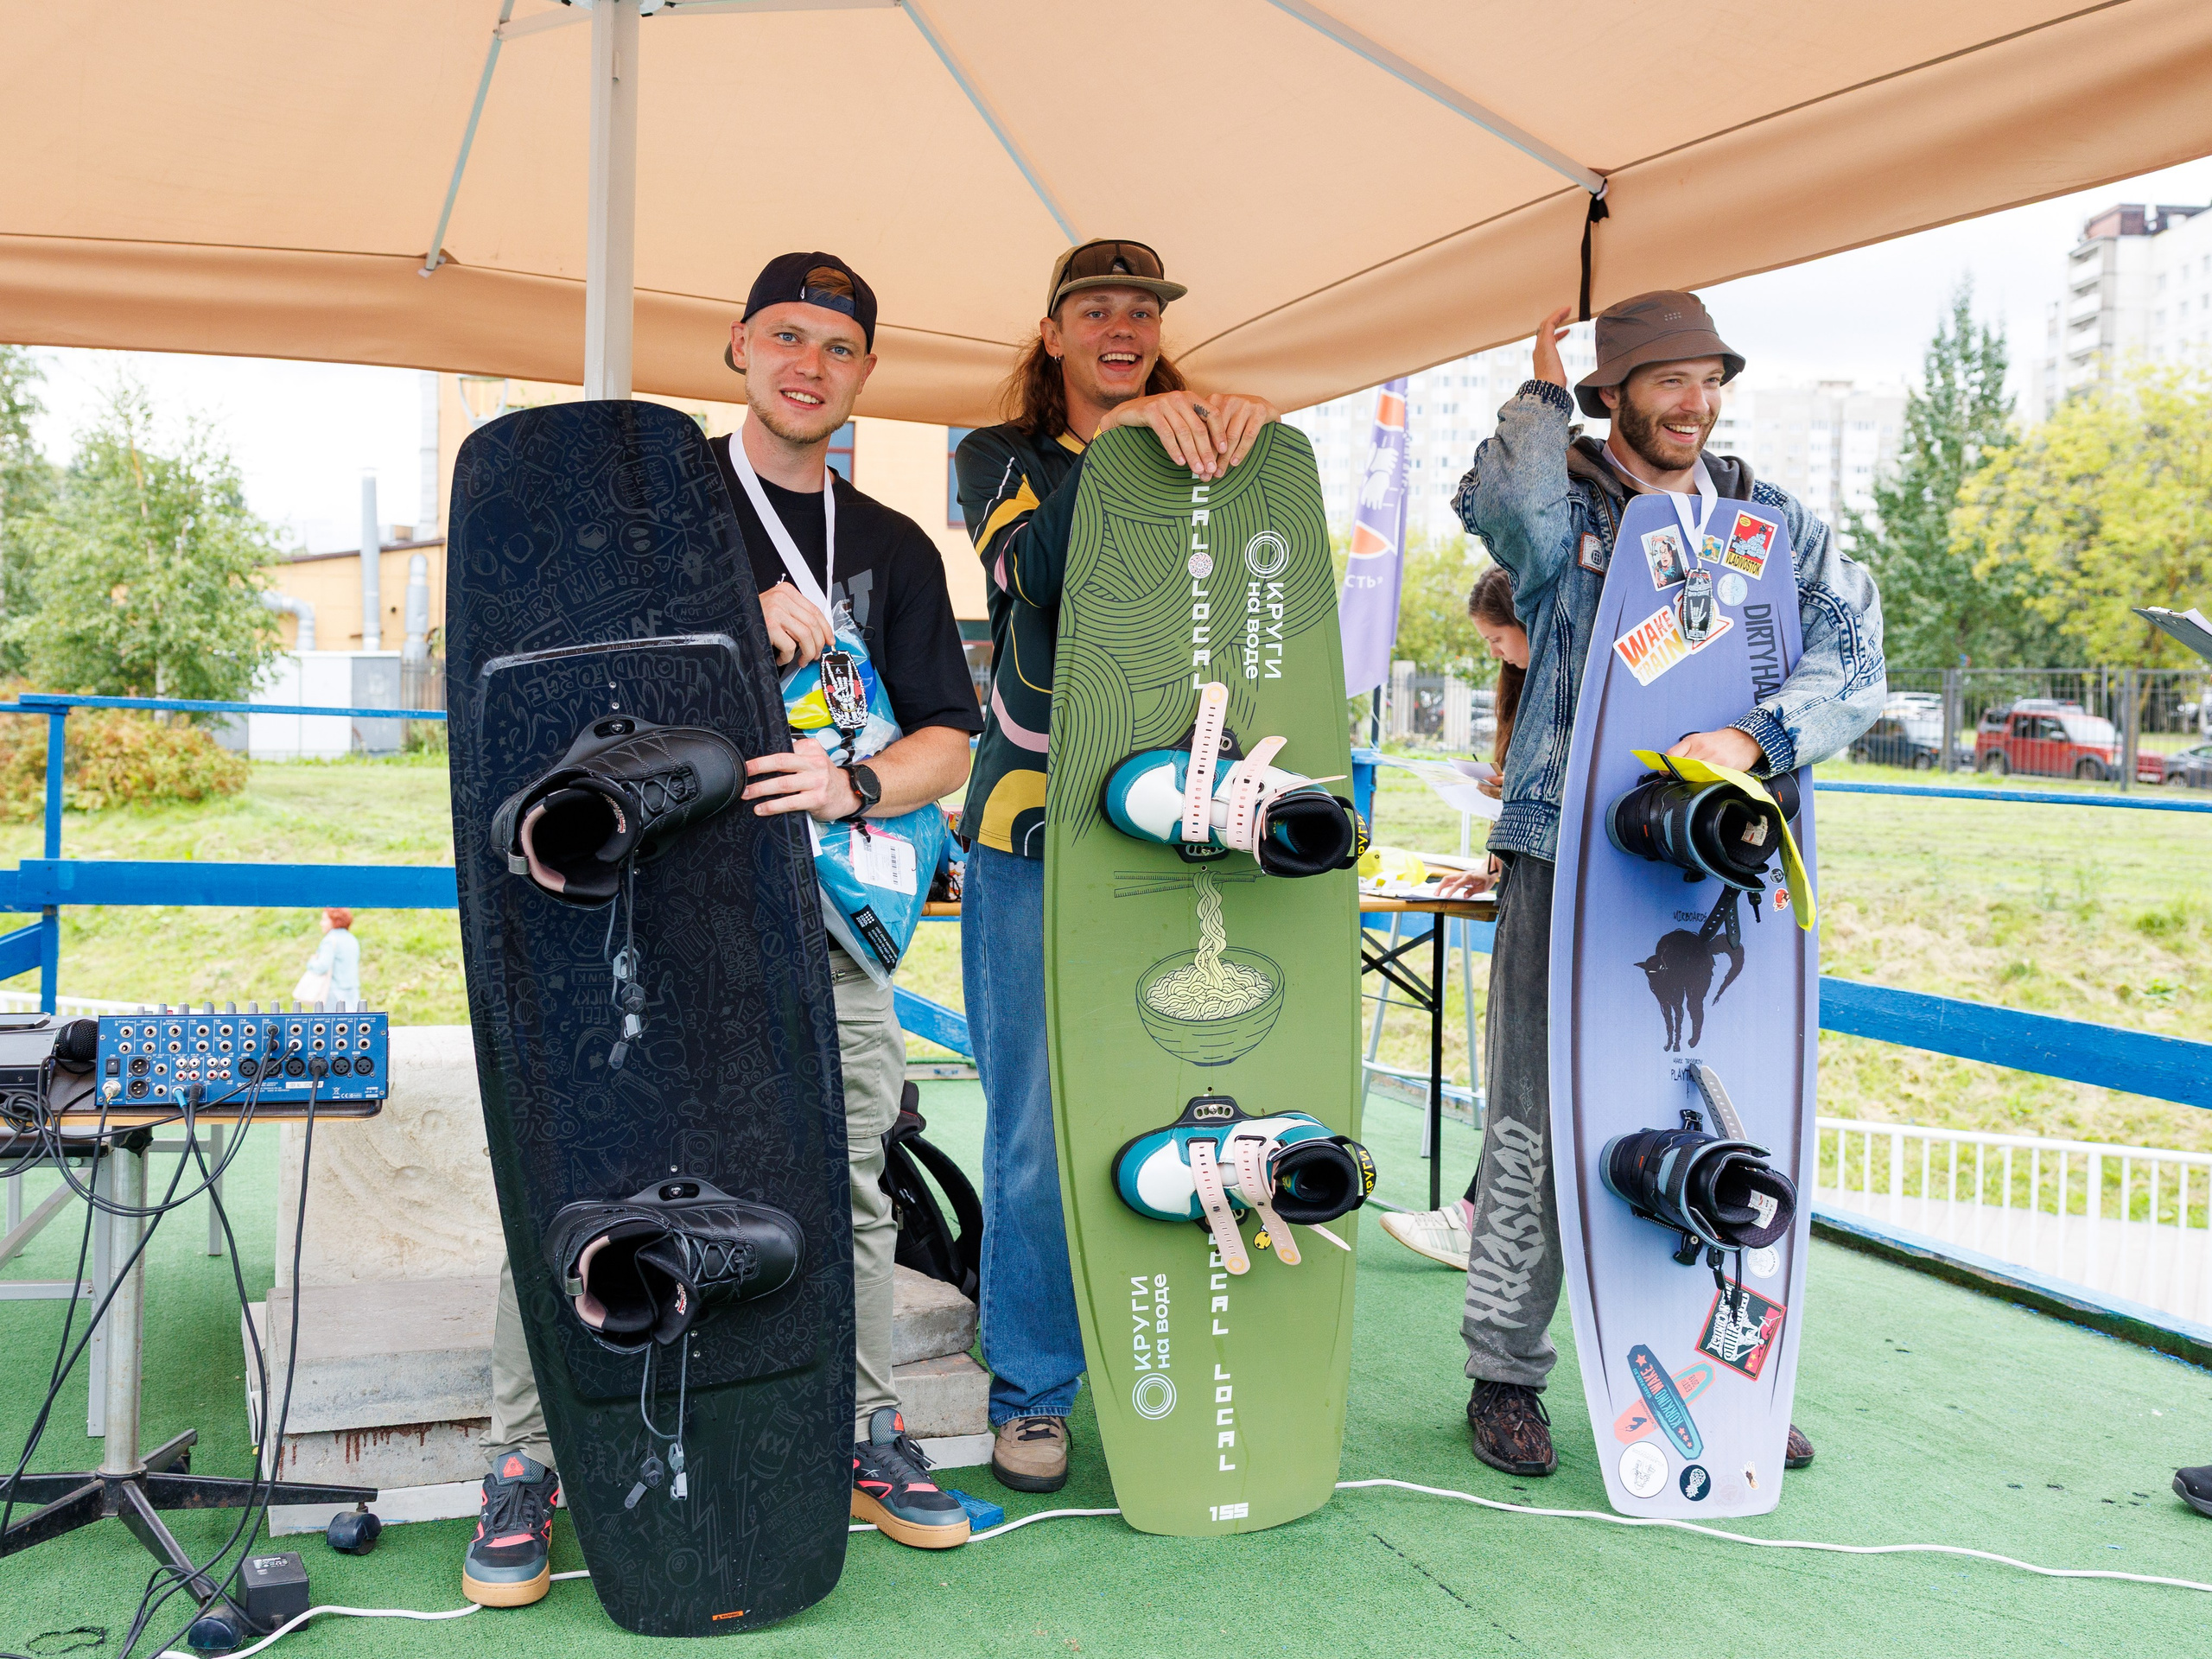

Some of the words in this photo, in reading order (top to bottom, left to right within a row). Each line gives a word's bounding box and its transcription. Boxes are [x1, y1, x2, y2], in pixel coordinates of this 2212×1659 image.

[1726, 550, 1763, 576] VLADIVOSTOK
[512, 583, 564, 632] TRY
[1247, 582, 1261, 613] на
[1192, 580, 1211, 690] LOCAL
[1244, 619, 1260, 680] воде
[1264, 582, 1284, 679] КРУГИ
[1618, 609, 1675, 669] WAKE
[1636, 627, 1688, 682] TRAIN
[1743, 603, 1779, 666] DIRTY
[1130, 1275, 1152, 1371] КРУГИ
[1154, 1273, 1170, 1334] воде
[1156, 1338, 1171, 1369] на
[1213, 1364, 1236, 1471] LOCAL
